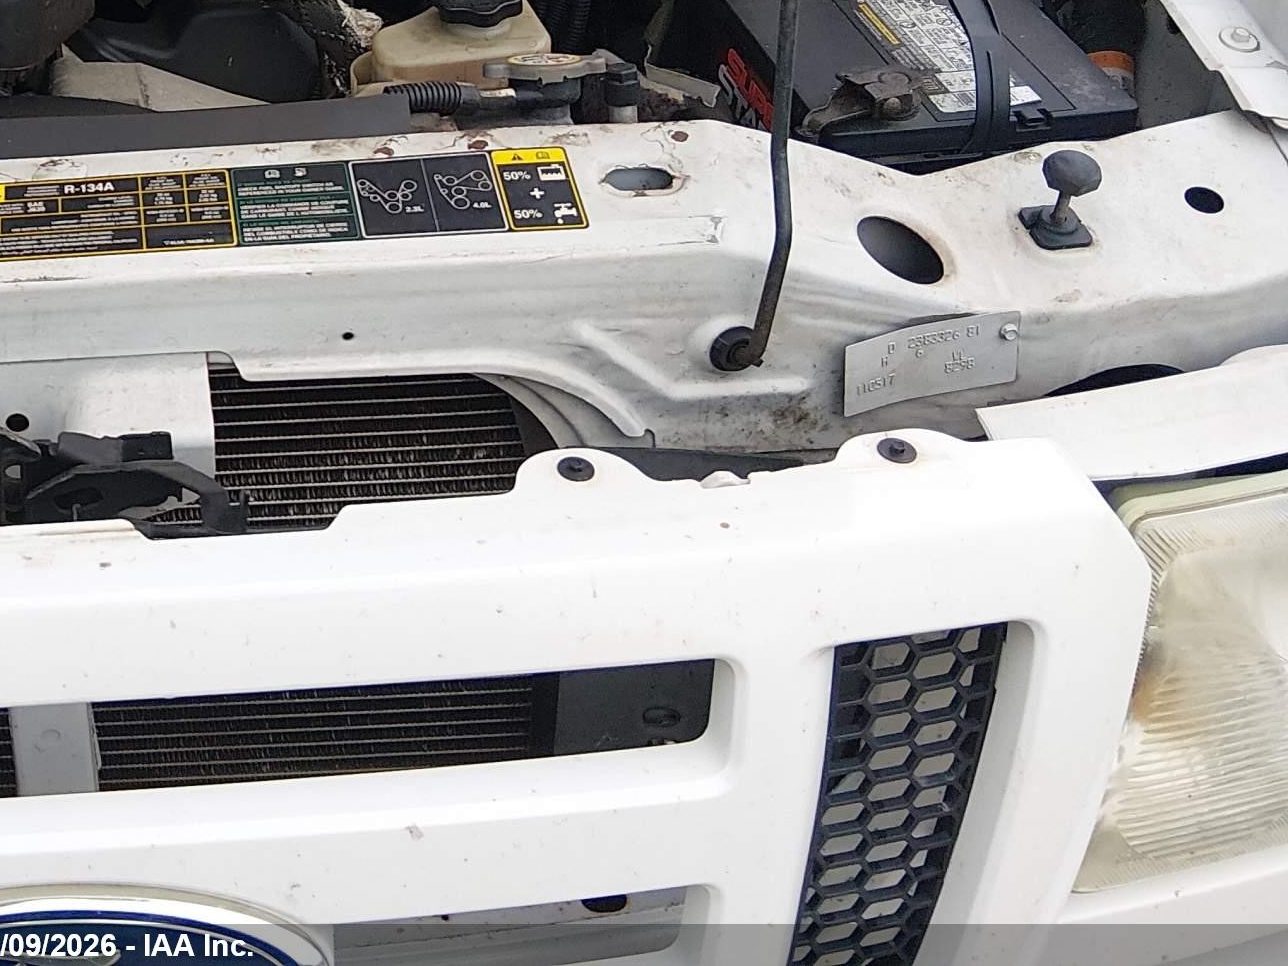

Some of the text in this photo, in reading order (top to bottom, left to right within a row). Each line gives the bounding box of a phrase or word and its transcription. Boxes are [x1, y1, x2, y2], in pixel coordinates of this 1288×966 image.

[502, 170, 531, 181] 50%
[64, 182, 115, 194] R-134A
[513, 209, 543, 219] 50%
